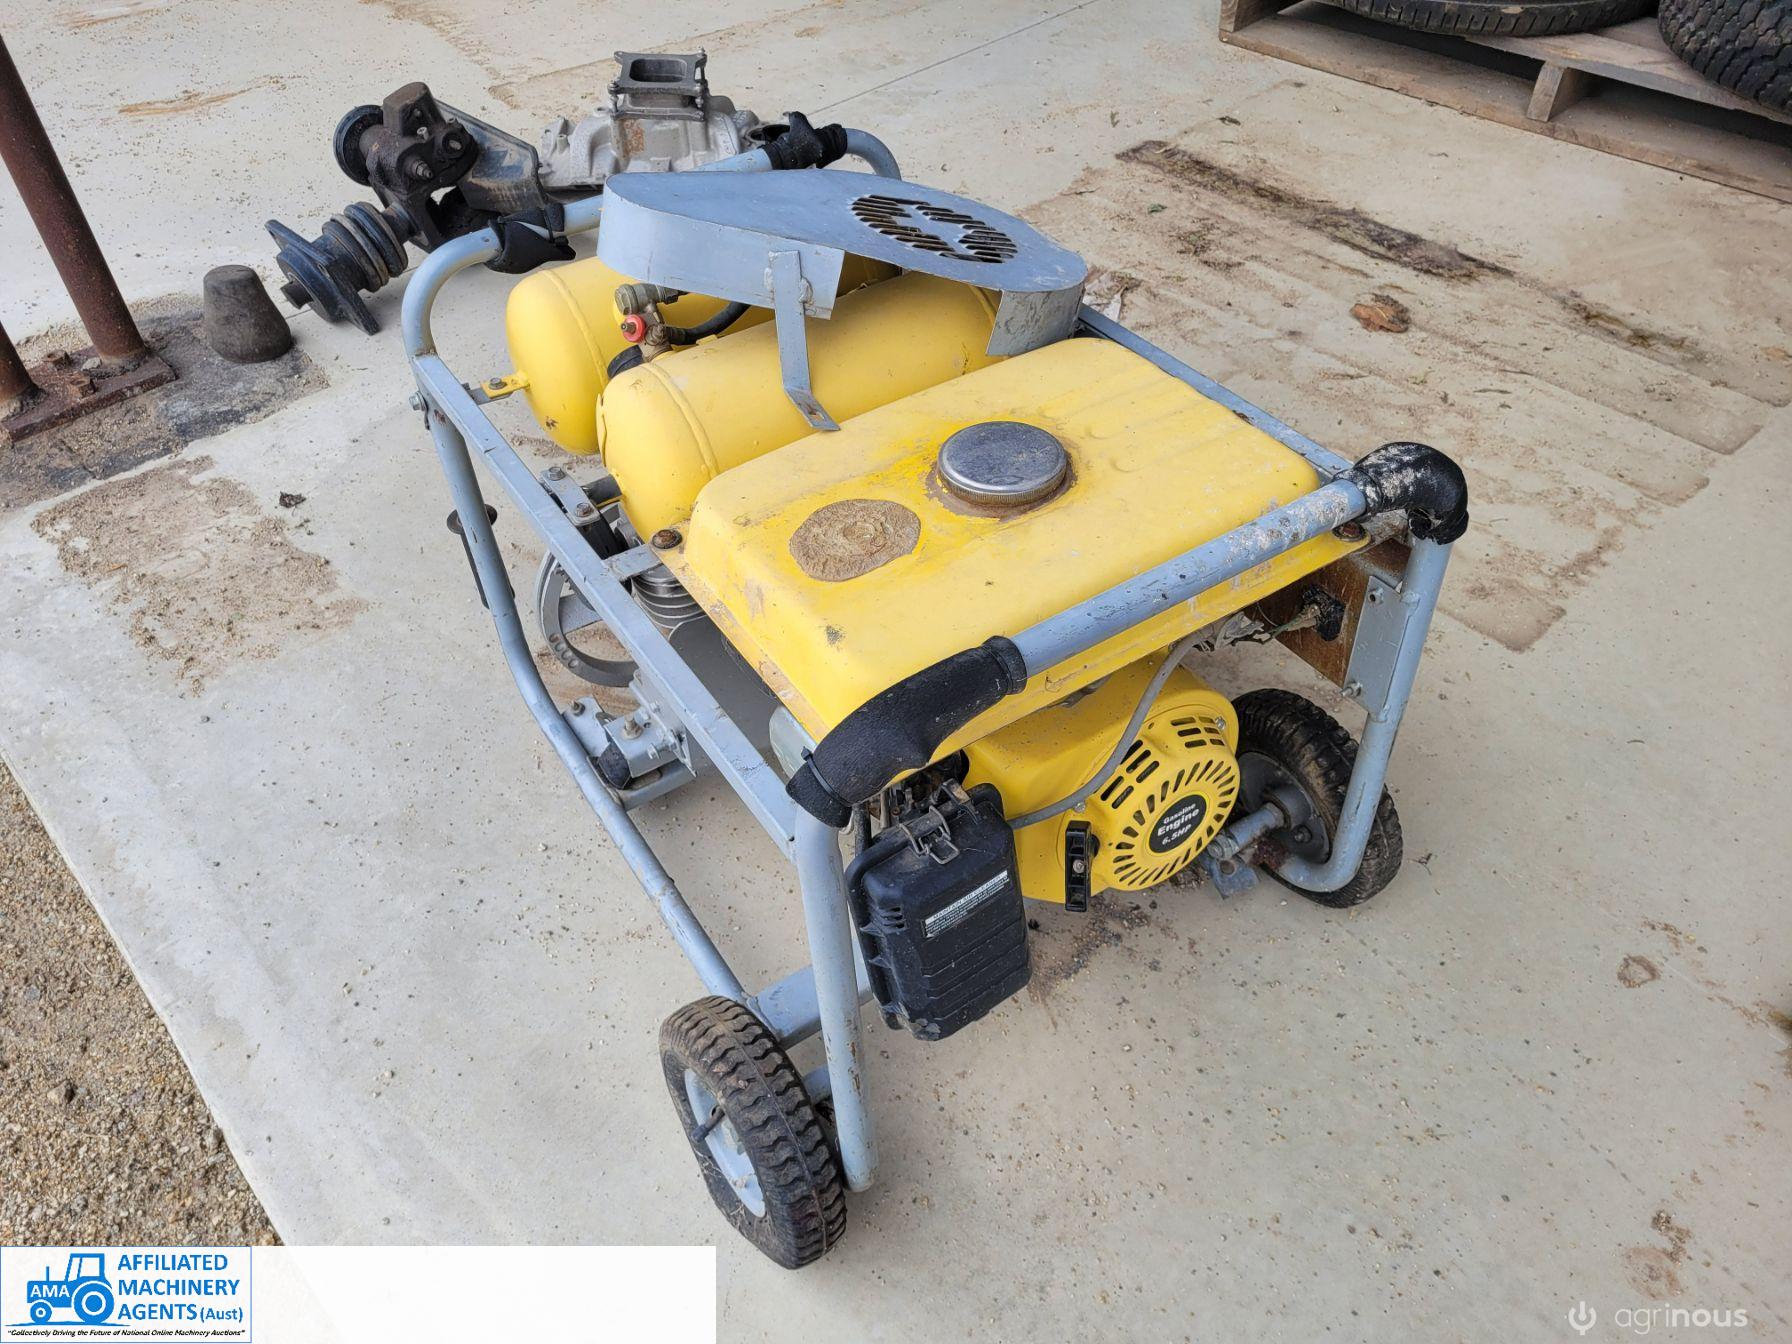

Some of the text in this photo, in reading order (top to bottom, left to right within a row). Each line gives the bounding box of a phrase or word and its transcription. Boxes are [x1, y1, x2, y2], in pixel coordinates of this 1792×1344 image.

[1157, 809, 1199, 837] Engine
[1163, 803, 1196, 824] Gasoline
[1162, 824, 1192, 845] 6.5HP
